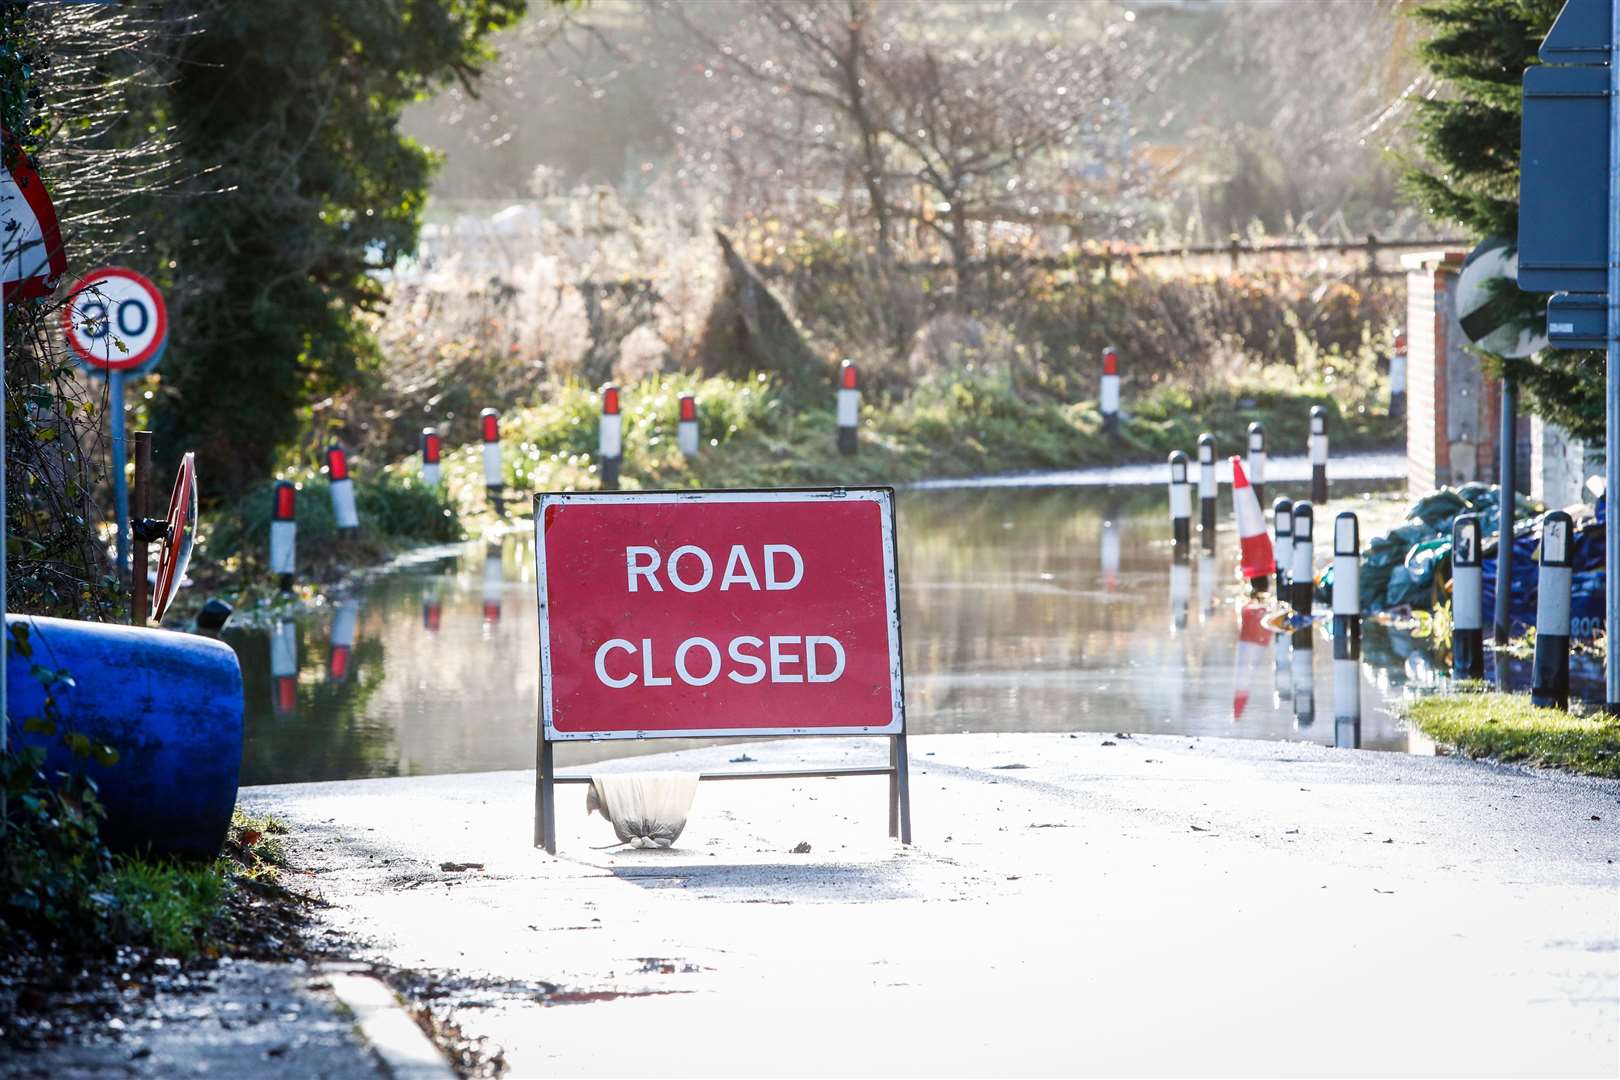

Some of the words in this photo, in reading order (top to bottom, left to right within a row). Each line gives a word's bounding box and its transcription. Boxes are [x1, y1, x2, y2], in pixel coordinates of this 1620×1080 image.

[80, 299, 149, 338] 30
[625, 544, 804, 593] ROAD
[594, 635, 846, 689] CLOSED
